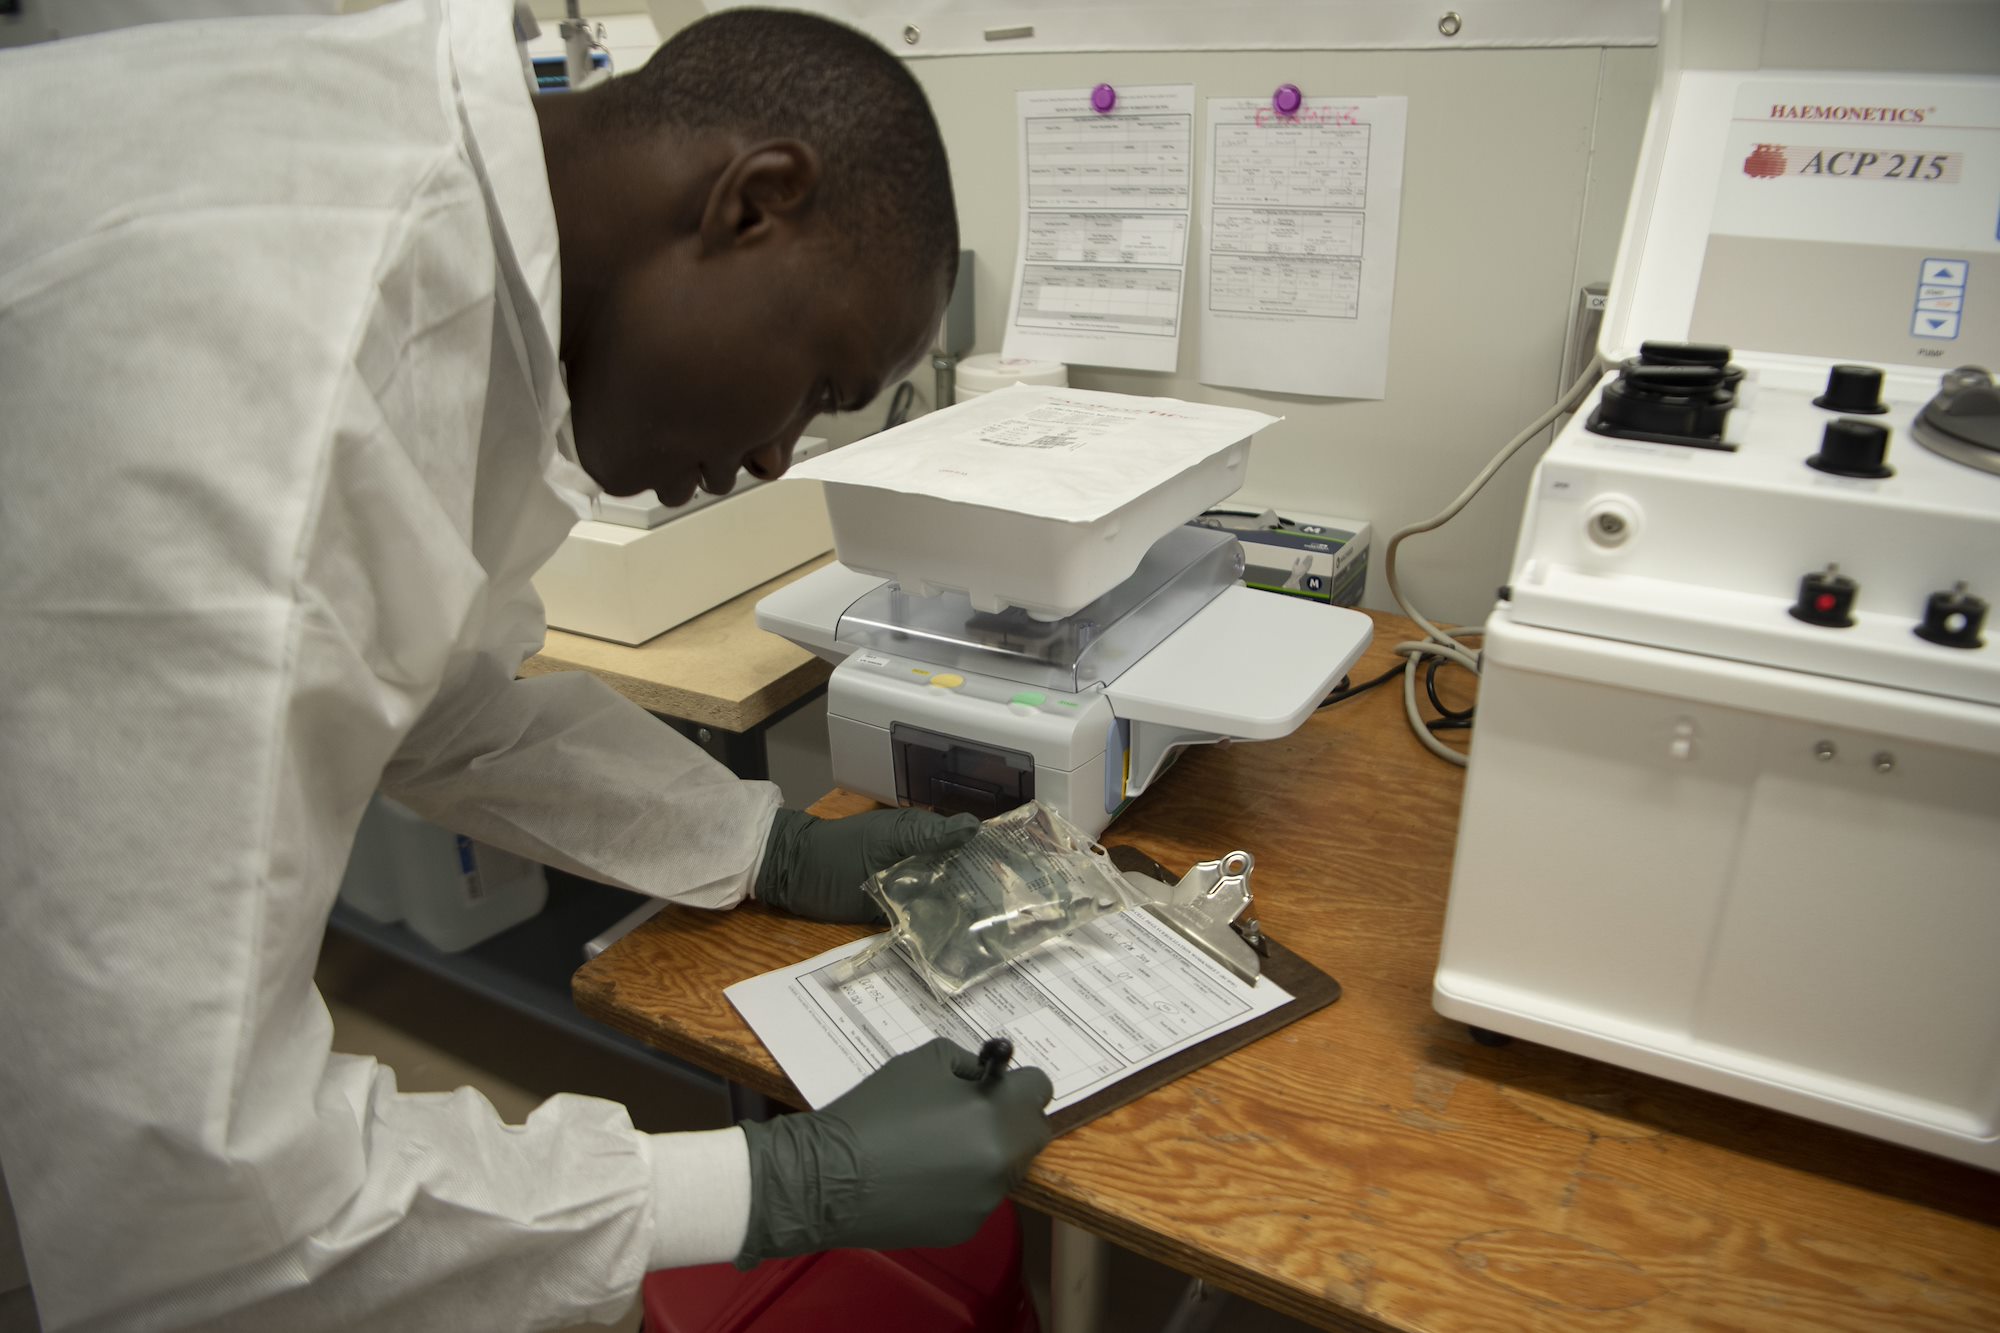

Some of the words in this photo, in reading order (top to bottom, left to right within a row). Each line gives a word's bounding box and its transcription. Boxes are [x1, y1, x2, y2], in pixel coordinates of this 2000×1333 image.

[1800, 150, 1878, 177] ACP
[1884, 153, 1949, 180] 215
[1309, 578, 1319, 589] M
